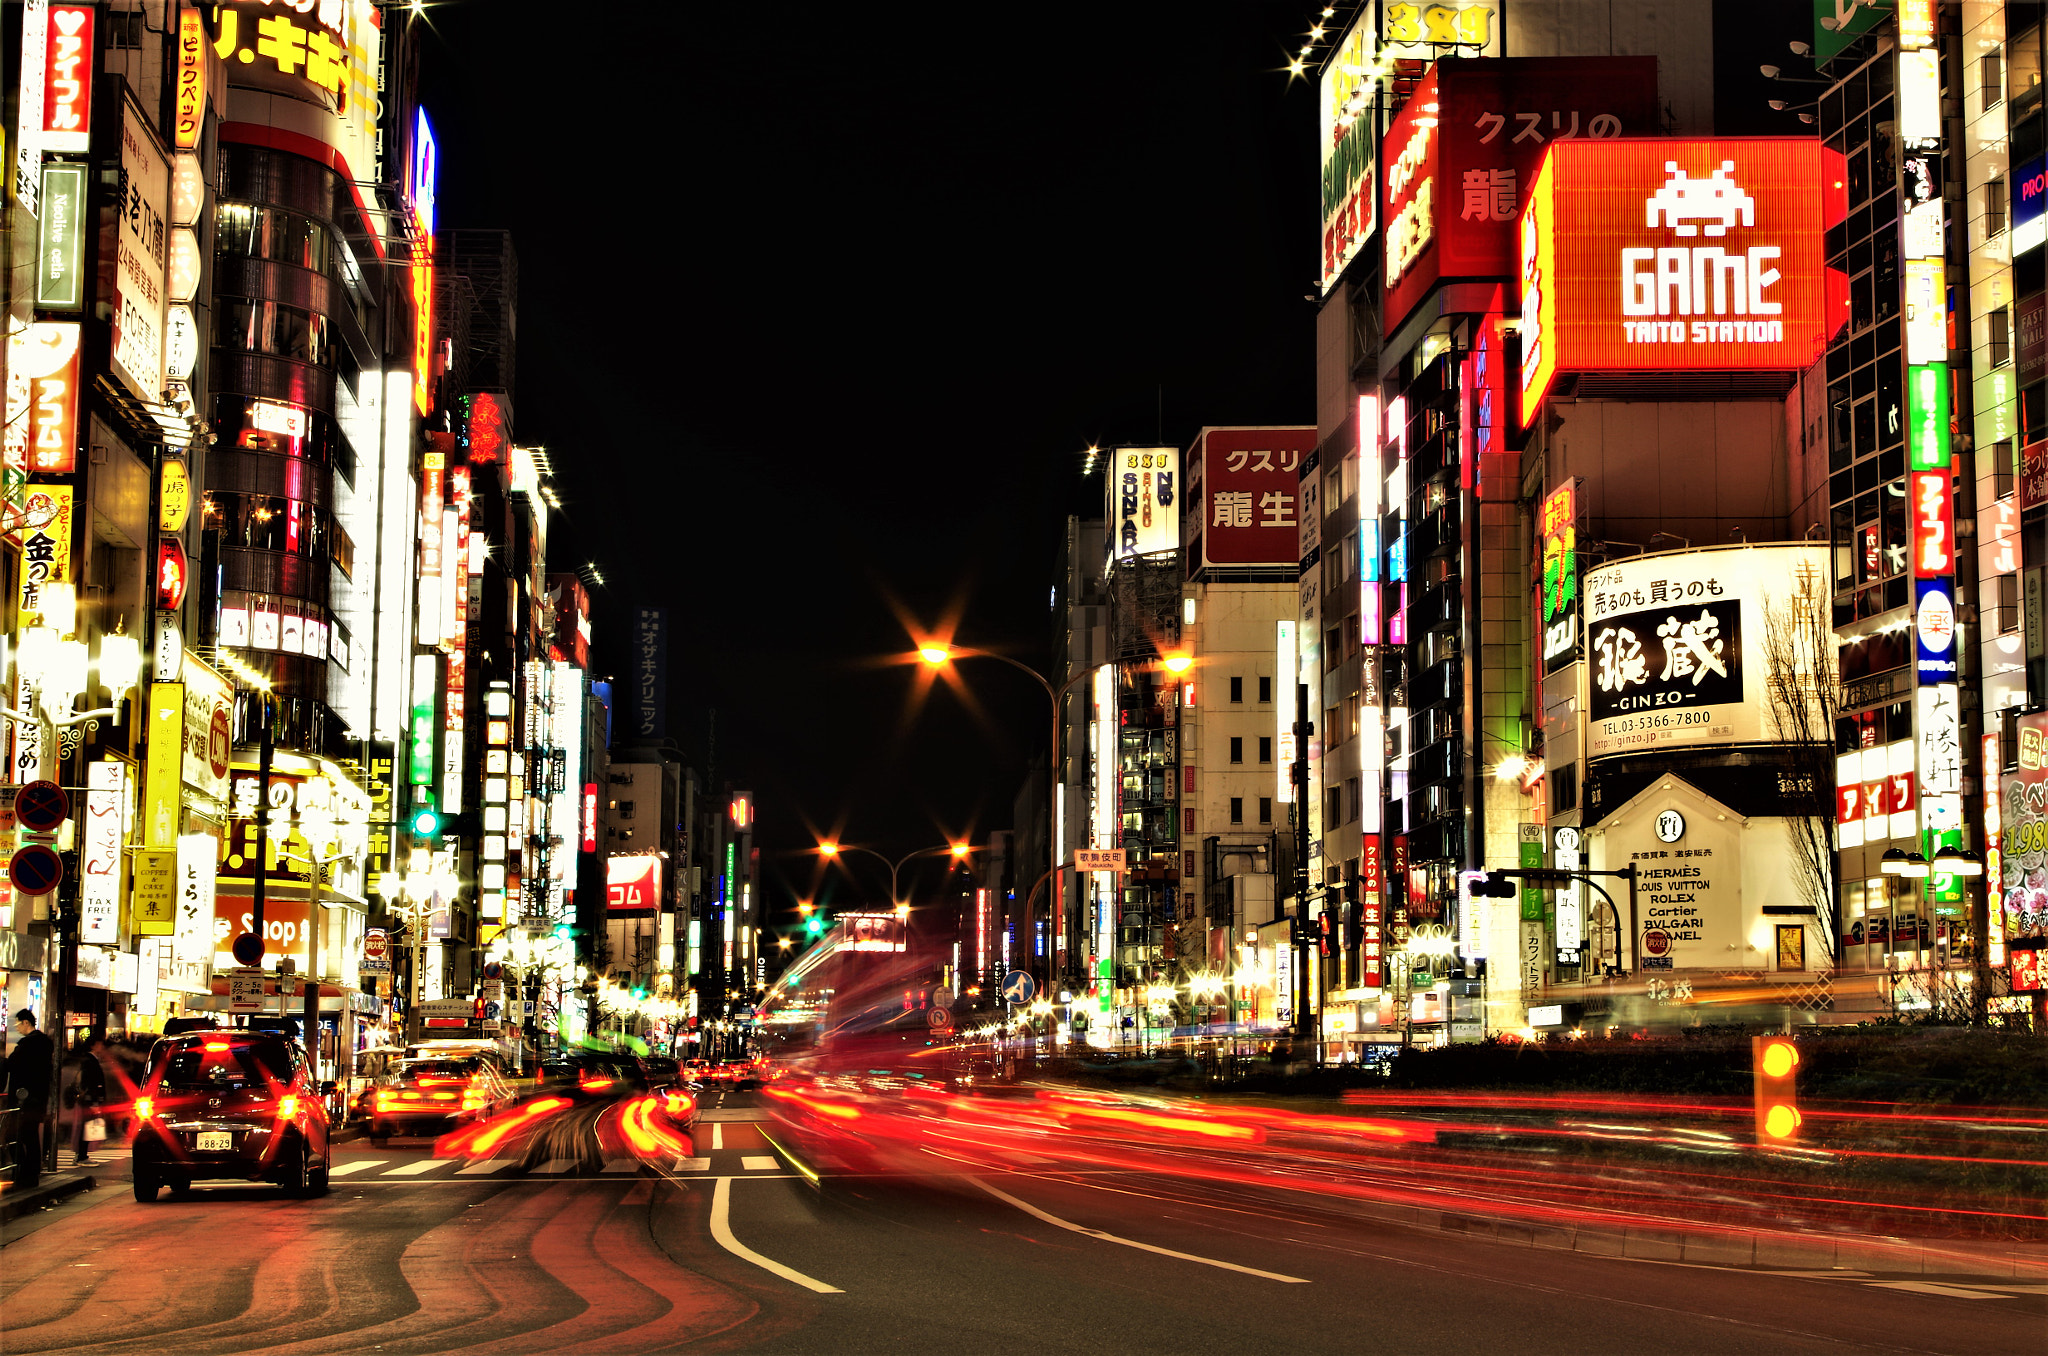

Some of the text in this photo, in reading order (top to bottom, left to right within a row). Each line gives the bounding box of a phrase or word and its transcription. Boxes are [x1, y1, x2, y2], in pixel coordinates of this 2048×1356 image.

[1387, 3, 1494, 48] 389
[51, 36, 86, 129] アイフル
[1474, 110, 1623, 145] クスリの
[52, 193, 69, 243] Neolive
[1621, 246, 1782, 316] GAME
[2021, 312, 2044, 329] FAST
[1623, 321, 1783, 343] TAITO STATION
[2022, 329, 2044, 350] NAIL
[38, 379, 66, 448] アコム
[37, 452, 61, 467] 3F
[1127, 454, 1168, 469] 389
[1225, 449, 1299, 473] クスリ
[1157, 472, 1174, 506] NEW
[1121, 472, 1139, 554] SUNPARK
[1919, 475, 1948, 571] アイフル
[1587, 569, 1623, 592] ブランド品
[1544, 613, 1575, 661] カワノ
[1593, 608, 1728, 693] 銀蔵
[641, 631, 658, 735] オザキクリニック
[1594, 729, 1657, 751] http://ginzo.jp
[1925, 691, 1958, 788] 大勝軒
[585, 794, 596, 841] SHIDAX
[1079, 852, 1122, 862] 歌舞伎町
[1631, 851, 1669, 860] 高価買取
[140, 869, 169, 877] COFFEE
[142, 883, 165, 891] CAKE
[1637, 880, 1710, 892] OUIS VUITTON
[88, 897, 112, 906] TAX
[145, 901, 161, 917] 集
[1364, 845, 1381, 974] クスリの龍生堂薬局
[1650, 893, 1695, 905] ROLEX
[87, 906, 112, 915] FREE
[1648, 906, 1698, 918] Cartier
[1643, 918, 1704, 930] BVLGARI
[1784, 929, 1797, 939] 2F
[365, 940, 386, 950] 消火栓
[1646, 937, 1668, 948] 消火栓
[1528, 936, 1540, 1000] カワノ・トラスト
[203, 1139, 230, 1149] 88-29
